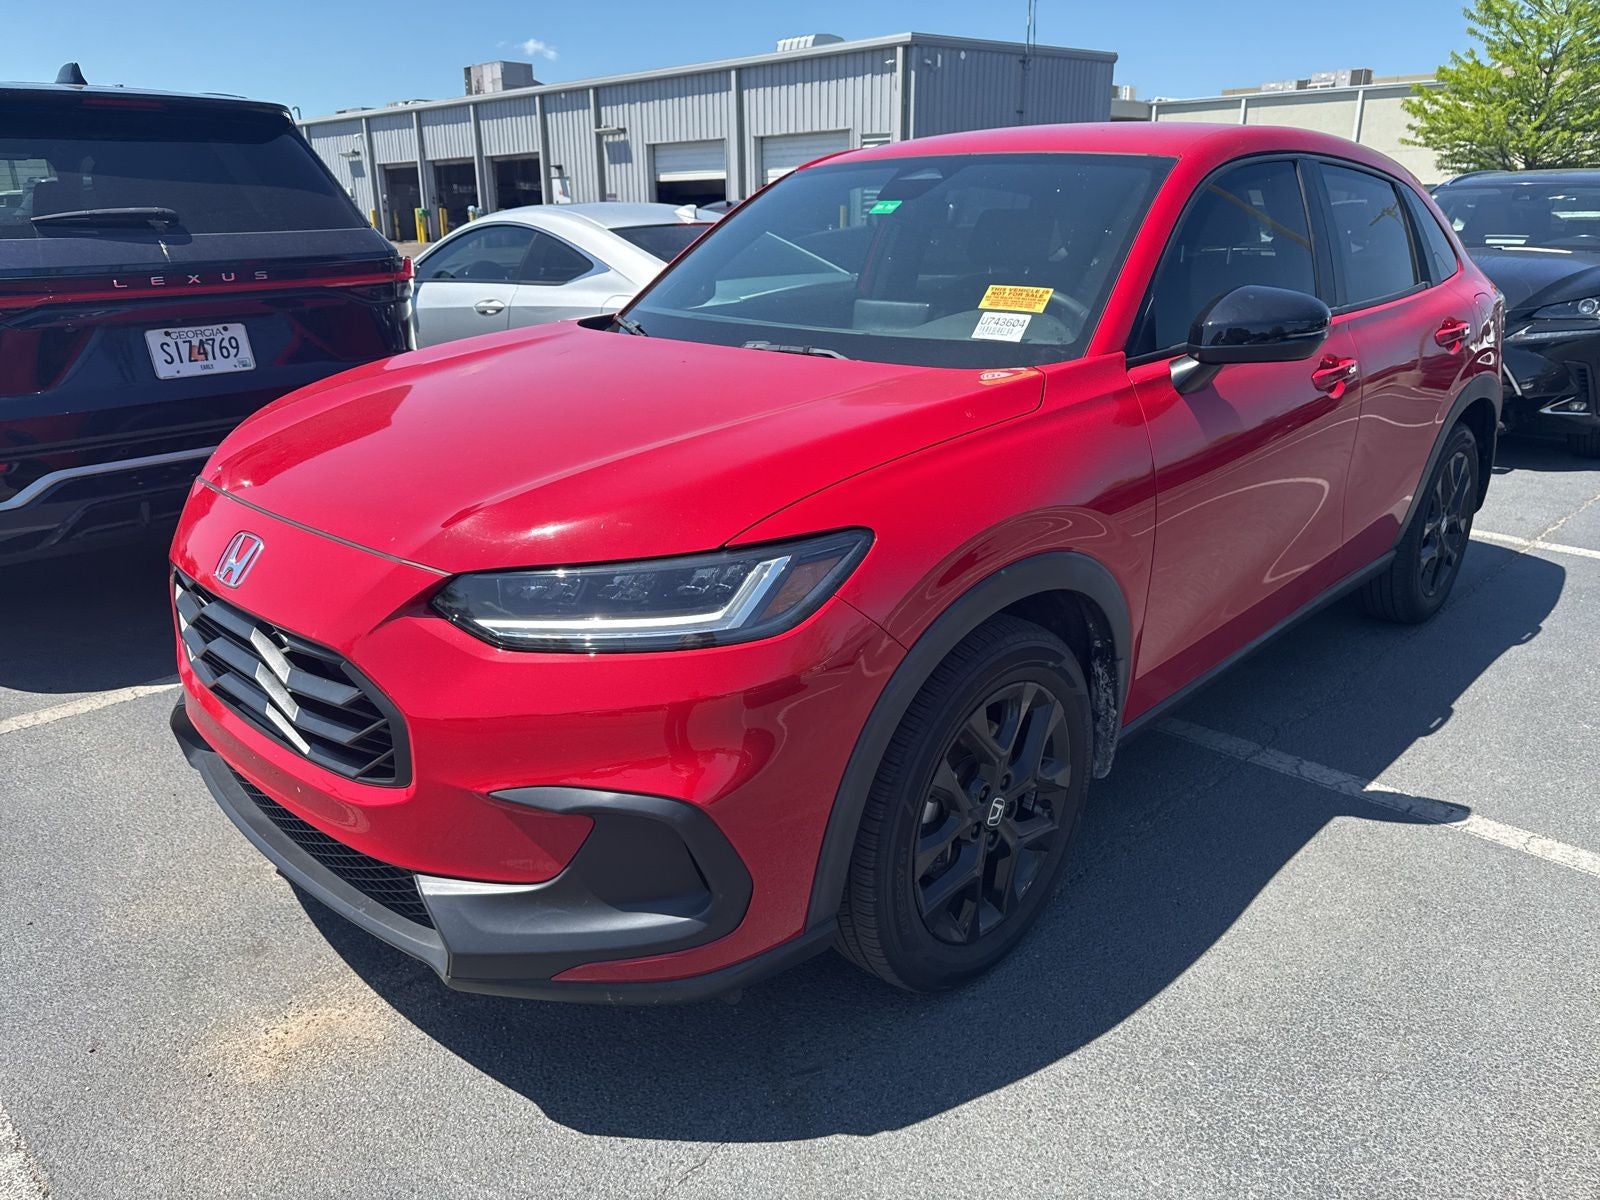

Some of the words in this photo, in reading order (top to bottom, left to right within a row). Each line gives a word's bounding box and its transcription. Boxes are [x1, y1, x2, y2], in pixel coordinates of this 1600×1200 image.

[112, 270, 268, 288] LEXUS
[980, 316, 1026, 328] U743604
[169, 328, 224, 340] GEORGIA
